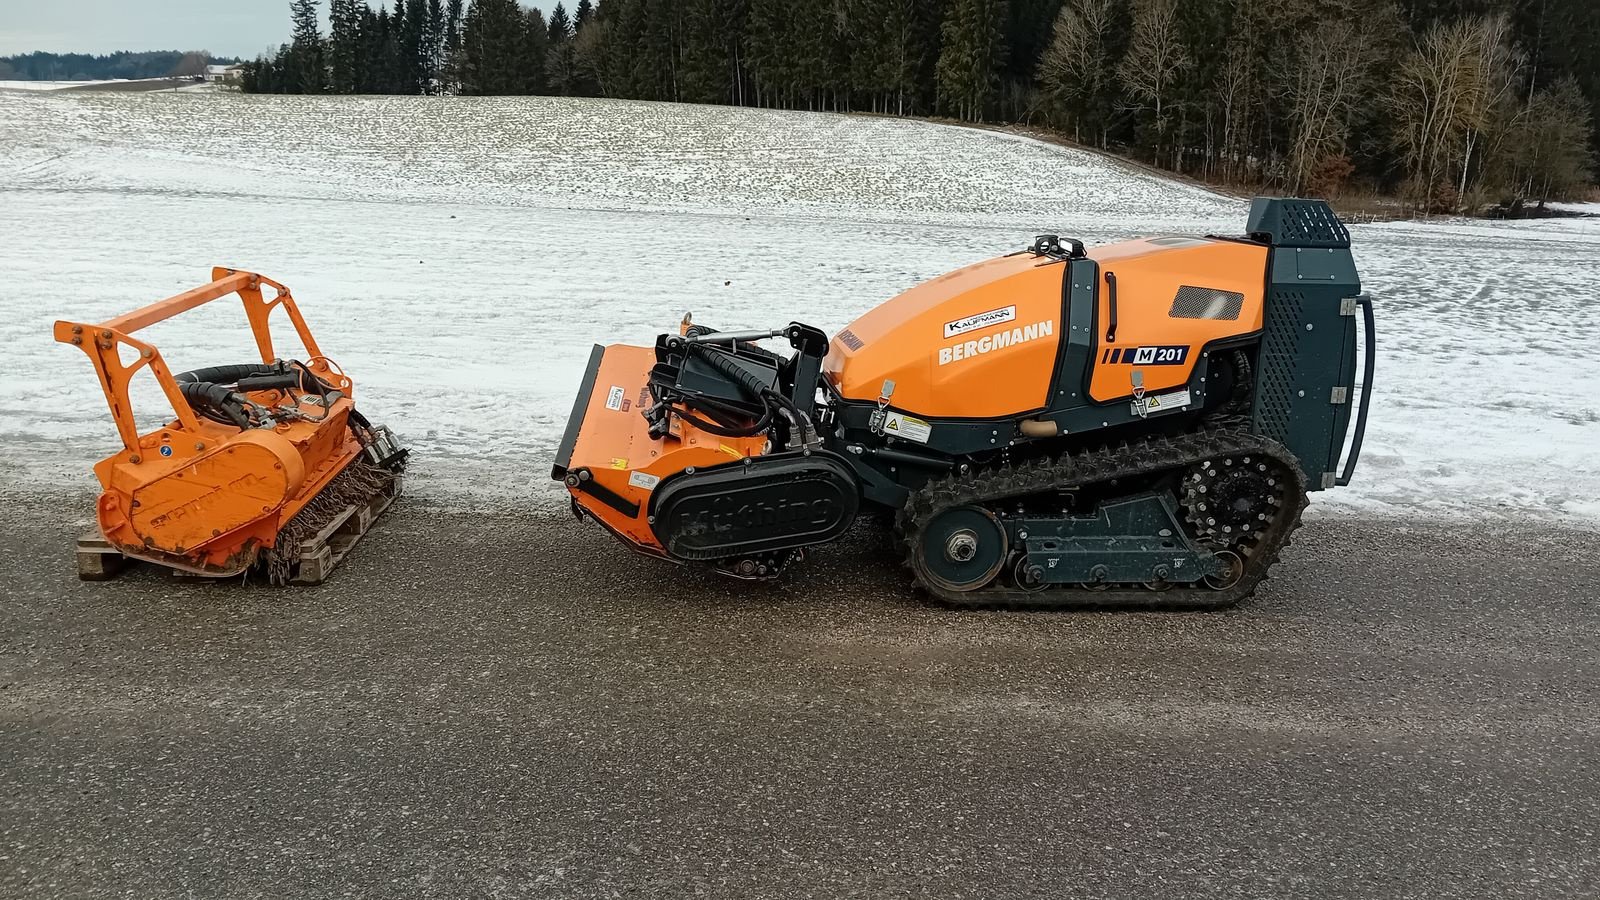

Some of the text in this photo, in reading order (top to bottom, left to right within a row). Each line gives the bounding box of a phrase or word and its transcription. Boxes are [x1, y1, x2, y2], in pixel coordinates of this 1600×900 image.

[938, 320, 1053, 366] BERGMANN
[1138, 348, 1183, 362] M 201
